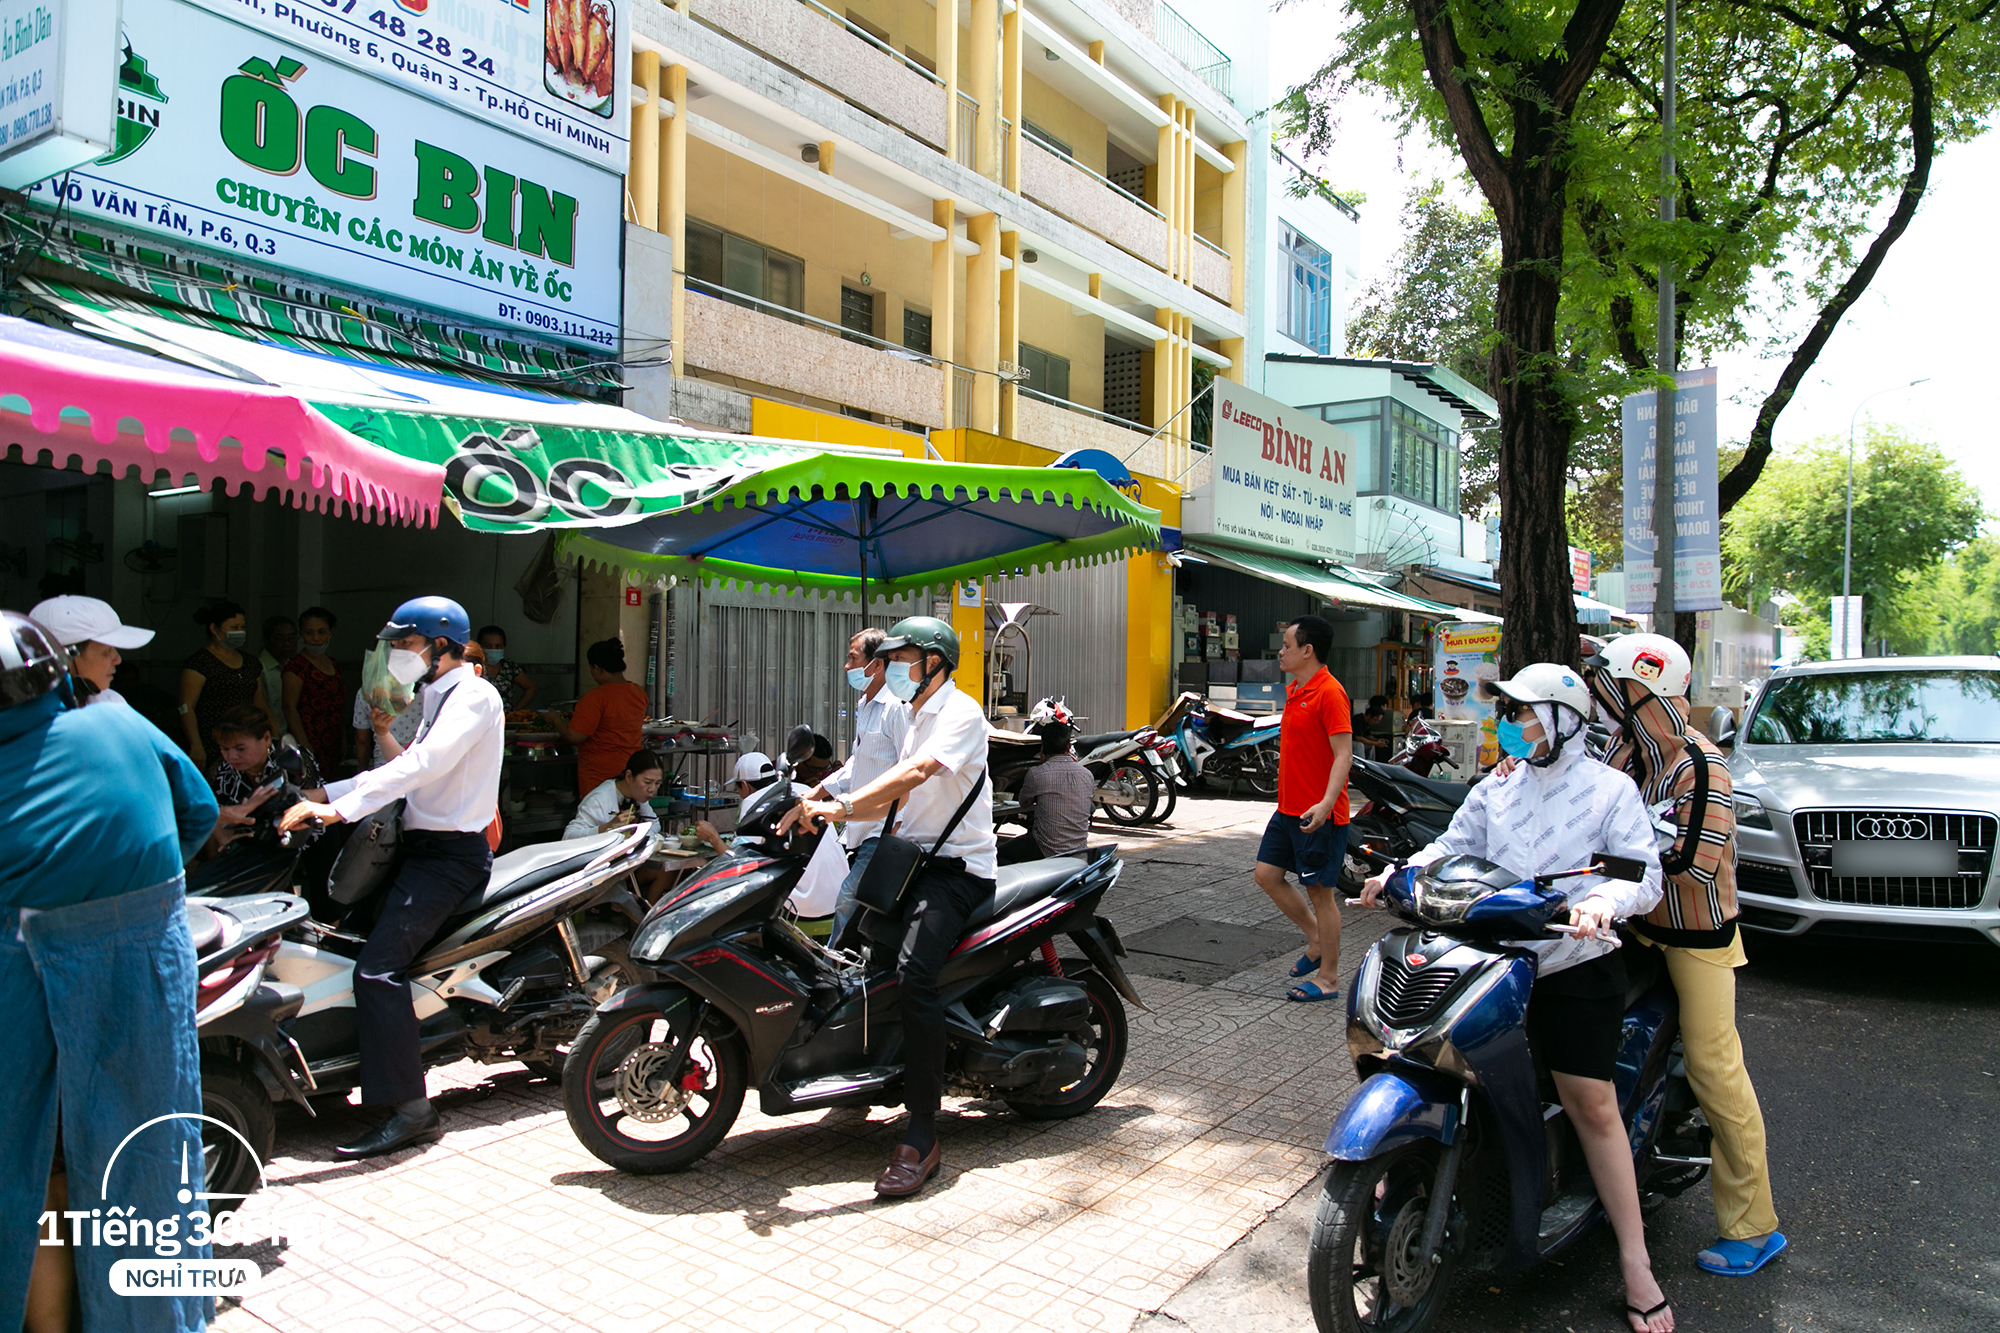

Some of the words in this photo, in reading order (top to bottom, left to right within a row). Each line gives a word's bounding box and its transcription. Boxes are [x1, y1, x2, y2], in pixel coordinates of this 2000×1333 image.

[35, 5, 51, 44] Dân
[368, 10, 406, 37] 48
[417, 29, 451, 57] 28
[462, 48, 495, 76] 24
[275, 2, 361, 55] Phường
[366, 42, 385, 63] 6,
[392, 52, 442, 84] Quận
[449, 75, 458, 91] 3
[475, 86, 529, 120] Tp.HỒ
[535, 111, 562, 134] CHÍ
[567, 125, 610, 154] MINH
[220, 55, 379, 201] ỐC
[413, 138, 579, 269] BIN
[52, 178, 82, 202] VÕ
[92, 188, 137, 218] VĂN
[144, 202, 193, 236] TẦN,
[201, 221, 238, 249] P.6,
[245, 233, 276, 256] Q.3
[216, 177, 342, 235] CHUYÊN
[347, 217, 403, 252] CÁC
[408, 234, 464, 271] MÓN
[469, 249, 503, 281] ĂN
[509, 259, 539, 294] VỀ
[544, 268, 573, 302] ỐC
[498, 302, 521, 322] ĐT:
[525, 310, 613, 346] 0903.111.212
[443, 425, 645, 523] ỐC
[1233, 409, 1262, 432] LEECO
[1261, 417, 1312, 474] BÌNH
[1319, 446, 1346, 486] AN
[1222, 465, 1241, 485] MUA
[1244, 471, 1261, 490] BÁN
[1282, 479, 1296, 501] SẮT
[1320, 495, 1333, 512] BÀN
[1339, 500, 1352, 517] GHẾ
[1260, 502, 1273, 522] NỘI
[1281, 508, 1303, 529] NGOẠI
[1468, 636, 1490, 645] ĐƯỢC
